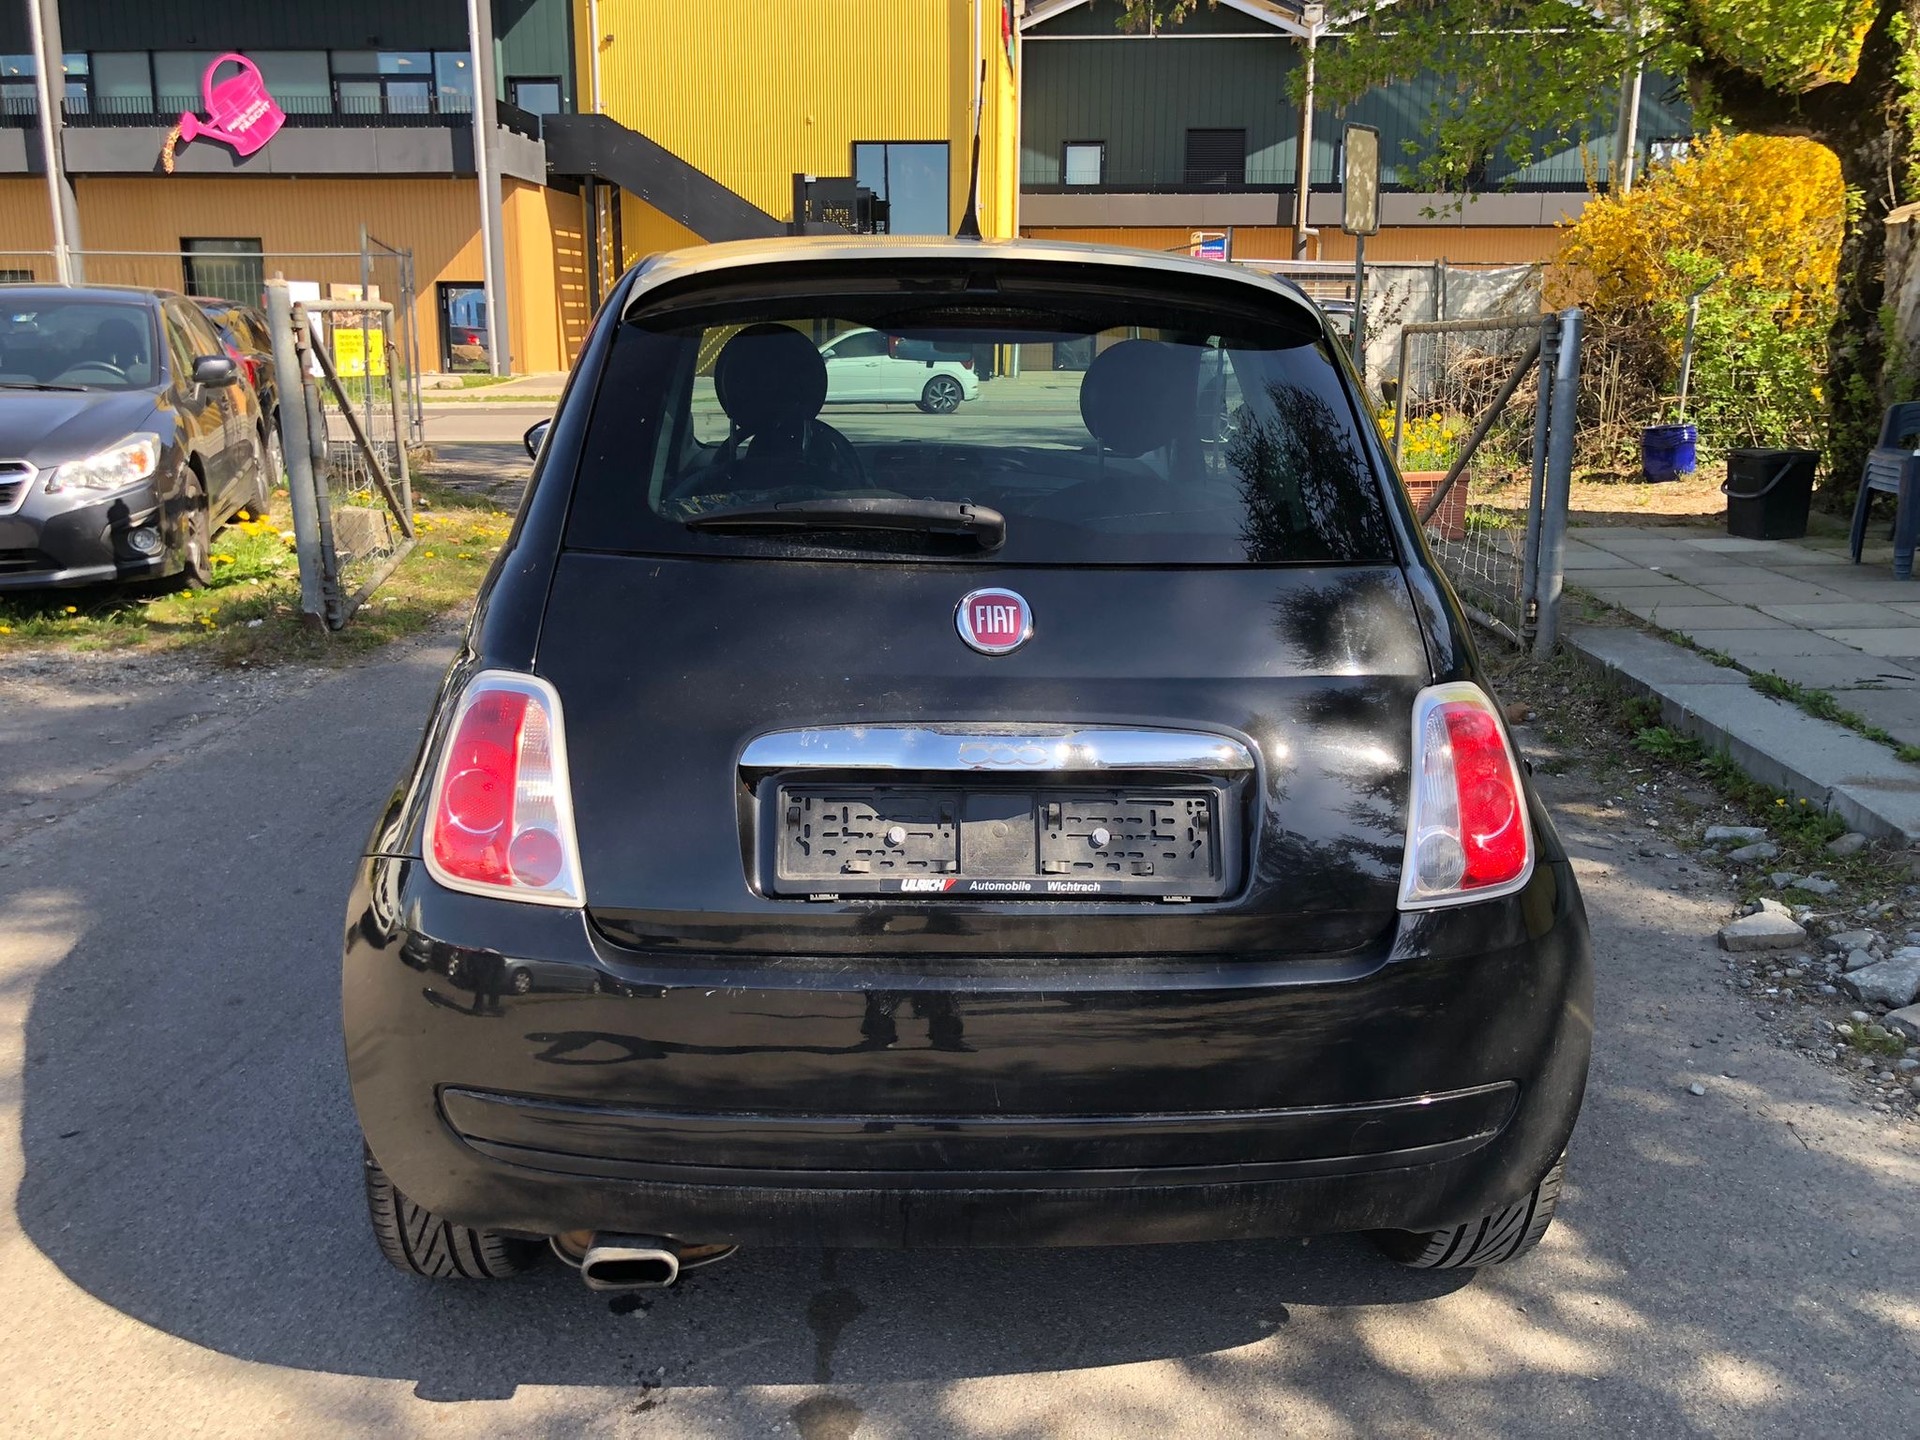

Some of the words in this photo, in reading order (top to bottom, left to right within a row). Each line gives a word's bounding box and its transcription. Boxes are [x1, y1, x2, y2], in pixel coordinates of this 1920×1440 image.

[975, 605, 1017, 634] FIAT
[901, 878, 946, 892] ULRICH
[969, 880, 1031, 892] Automobile
[1047, 881, 1101, 893] Wichtrach
